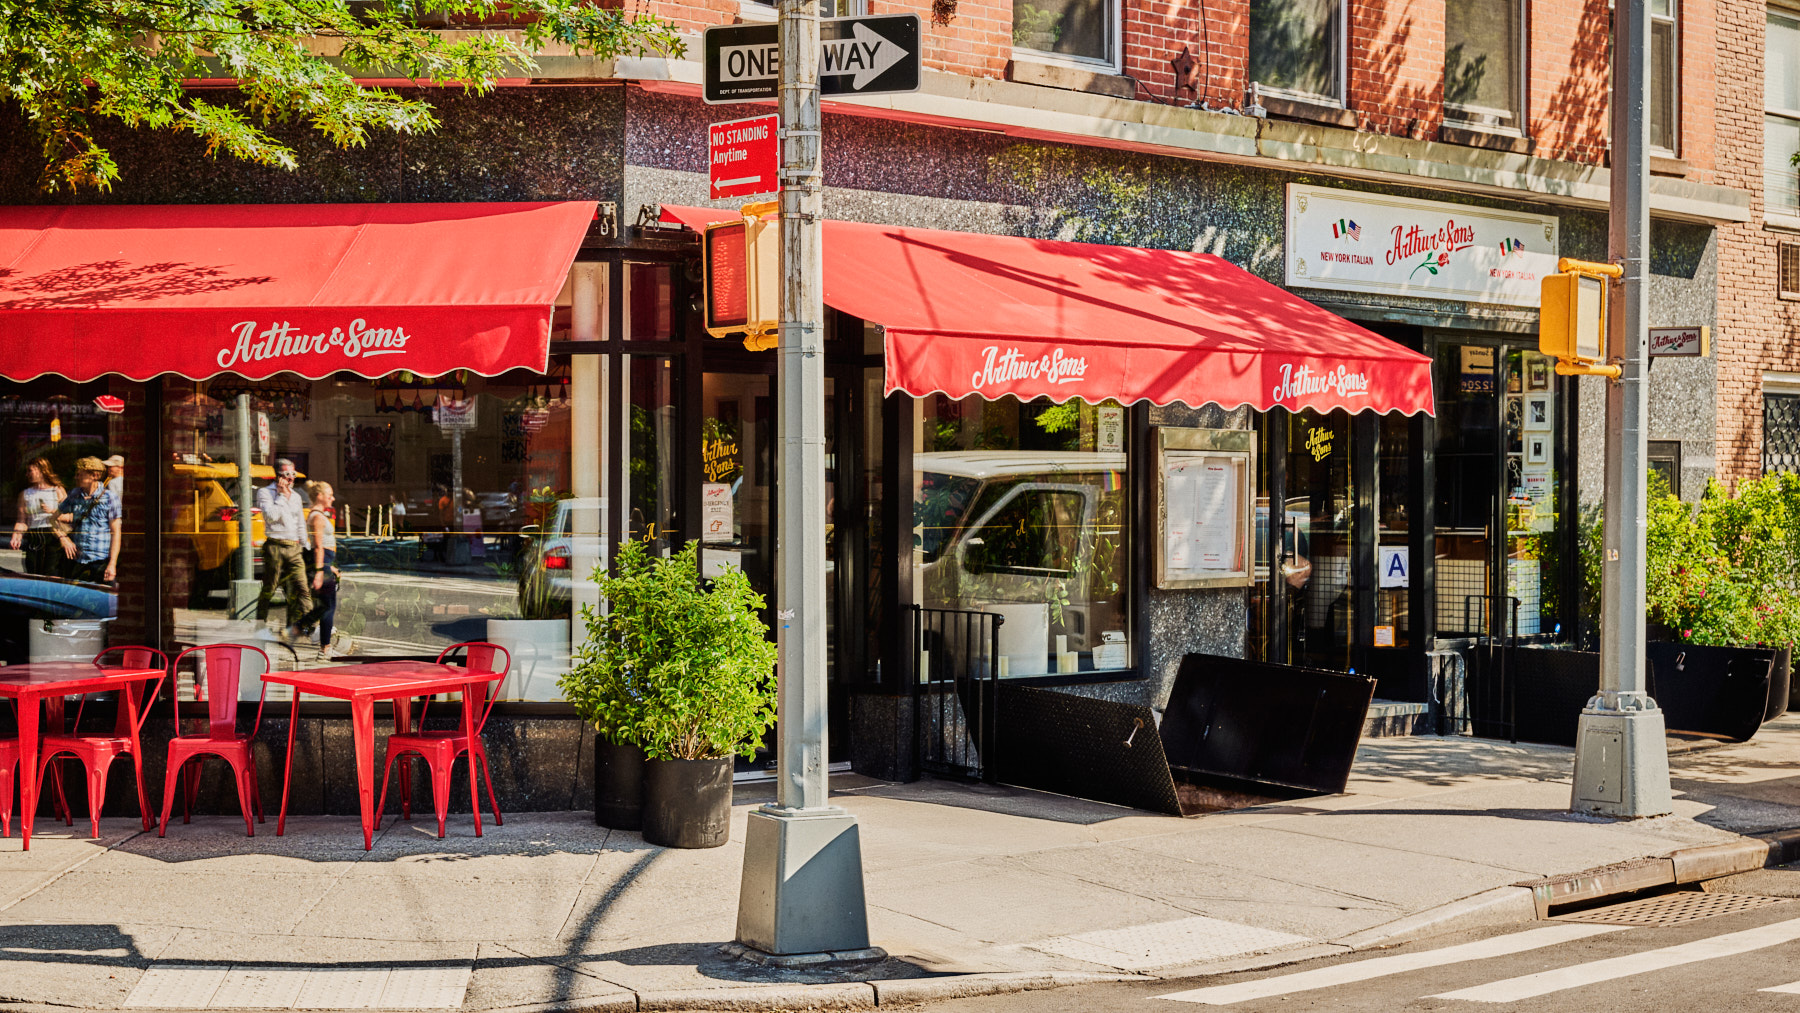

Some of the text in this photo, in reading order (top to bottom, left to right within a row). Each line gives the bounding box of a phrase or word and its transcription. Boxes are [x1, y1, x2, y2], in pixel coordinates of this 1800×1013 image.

[727, 41, 883, 78] ONE WAY
[712, 124, 769, 147] NO STANDING
[713, 147, 748, 166] Anytime
[1320, 251, 1374, 265] NEW YORK ITALIAN
[1489, 268, 1501, 278] NEW
[1502, 270, 1515, 279] YORK
[1305, 426, 1335, 450] Arthur
[642, 522, 658, 543] A
[1016, 518, 1026, 537] A
[1388, 552, 1406, 577] A
